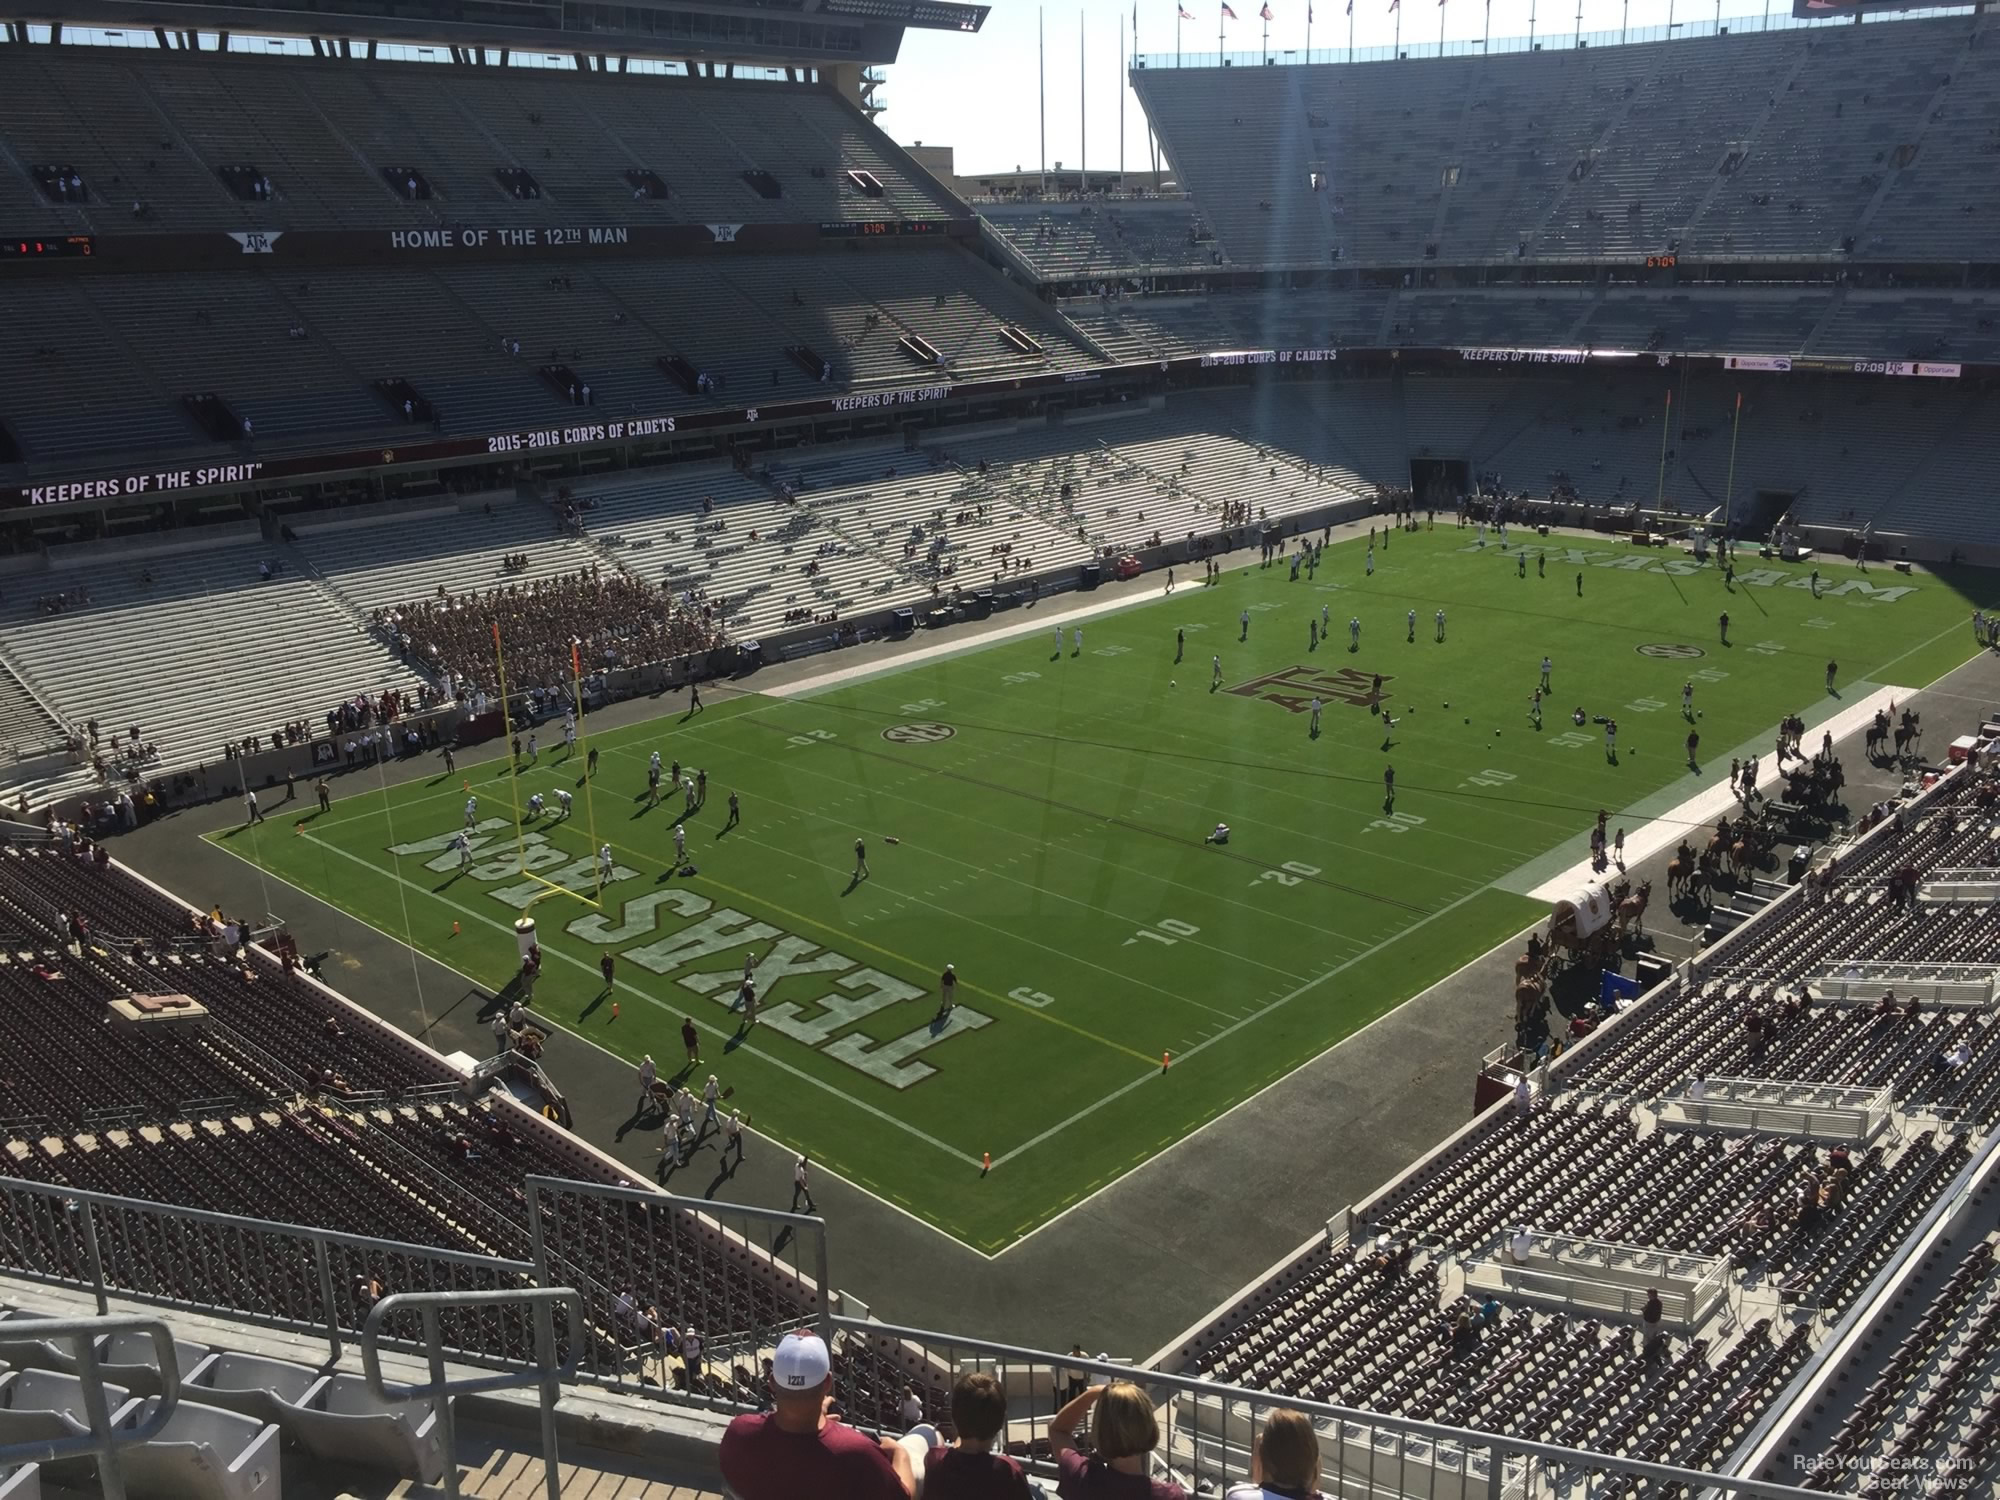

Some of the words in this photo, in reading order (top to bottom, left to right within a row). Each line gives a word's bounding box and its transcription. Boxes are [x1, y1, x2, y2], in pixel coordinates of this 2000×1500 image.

[391, 230, 454, 248] HOME
[462, 230, 489, 248] OF
[497, 229, 537, 246] THE
[544, 228, 582, 245] 12TH
[588, 228, 628, 244] MAN
[1200, 351, 1246, 368] 2015-2016
[1247, 351, 1277, 363] CORPS
[1279, 350, 1292, 362] OF
[1295, 349, 1337, 361] CADETS
[1459, 349, 1509, 362] "KEEPERS
[1511, 351, 1525, 362] OF
[1528, 352, 1549, 363] THE
[1854, 362, 1885, 373] 67:09
[831, 394, 880, 411] "KEEPERS
[882, 392, 896, 406] OF
[898, 390, 916, 404] THE
[918, 386, 953, 401] SPIRIT"
[488, 430, 560, 452] 2015-2016
[564, 425, 605, 444] CORPS
[608, 423, 624, 438] OF
[628, 417, 676, 437] CADETS
[21, 478, 120, 505] "KEEPERS
[125, 475, 150, 493] OF
[156, 471, 191, 490] THE
[196, 462, 263, 485] SPIRIT"
[1456, 539, 1713, 576] TEXAS
[1723, 568, 1919, 602] A&M
[1624, 698, 1668, 712] 40
[786, 729, 838, 745] 20
[886, 723, 951, 743] SEC
[1546, 731, 1597, 748] 50
[1467, 769, 1518, 786] 40
[1369, 811, 1427, 833] 30
[385, 816, 642, 909] A&M
[1260, 861, 1322, 887] 20
[1136, 918, 1201, 945] 10
[562, 888, 996, 1090] TEXAS
[1008, 986, 1055, 1008] G
